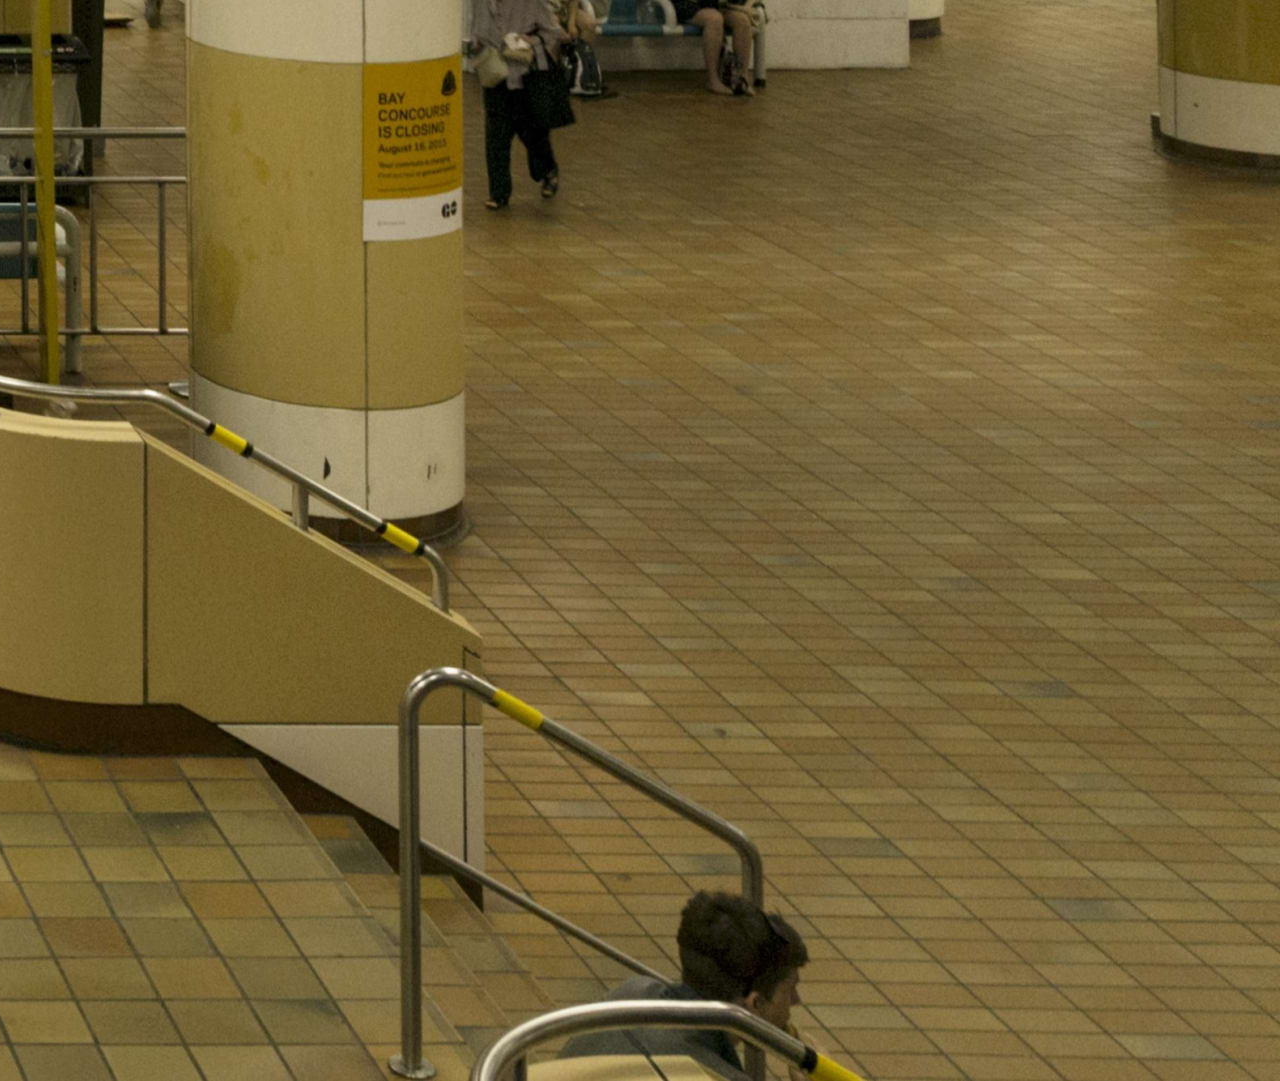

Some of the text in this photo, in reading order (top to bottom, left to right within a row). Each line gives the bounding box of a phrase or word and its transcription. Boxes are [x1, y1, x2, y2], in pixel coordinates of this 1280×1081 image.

[378, 91, 406, 105] BAY
[377, 102, 451, 122] CONCOURSE
[378, 120, 445, 139] IS CLOSING
[377, 143, 412, 156] August
